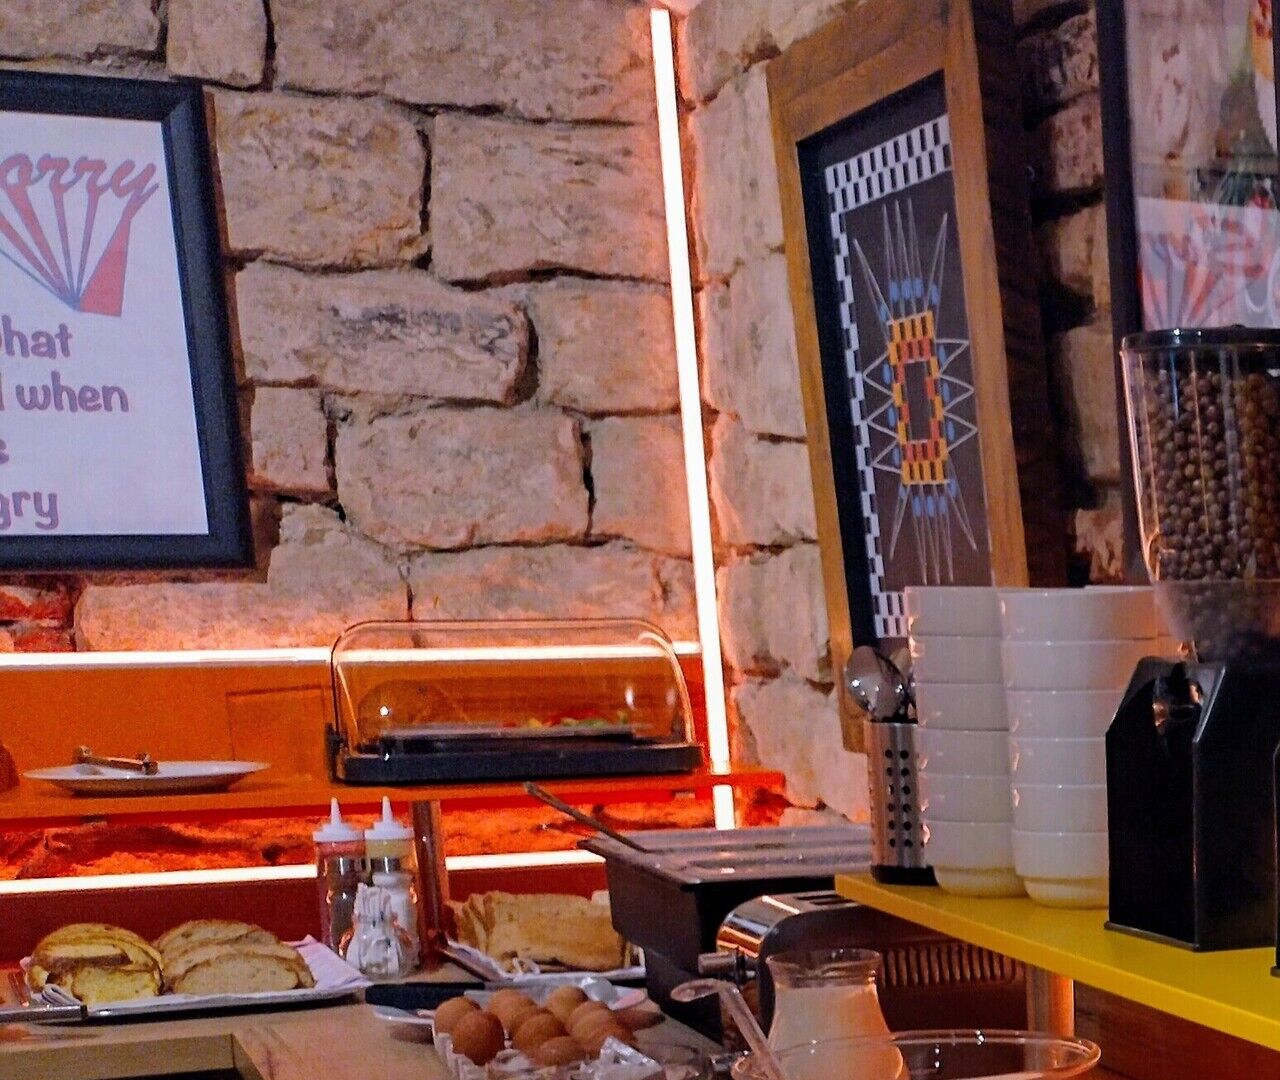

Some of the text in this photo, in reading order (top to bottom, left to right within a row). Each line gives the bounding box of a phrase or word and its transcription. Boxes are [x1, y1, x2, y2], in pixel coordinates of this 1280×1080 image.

[0, 315, 73, 359] hat
[15, 369, 129, 413] when
[0, 490, 59, 530] gry
